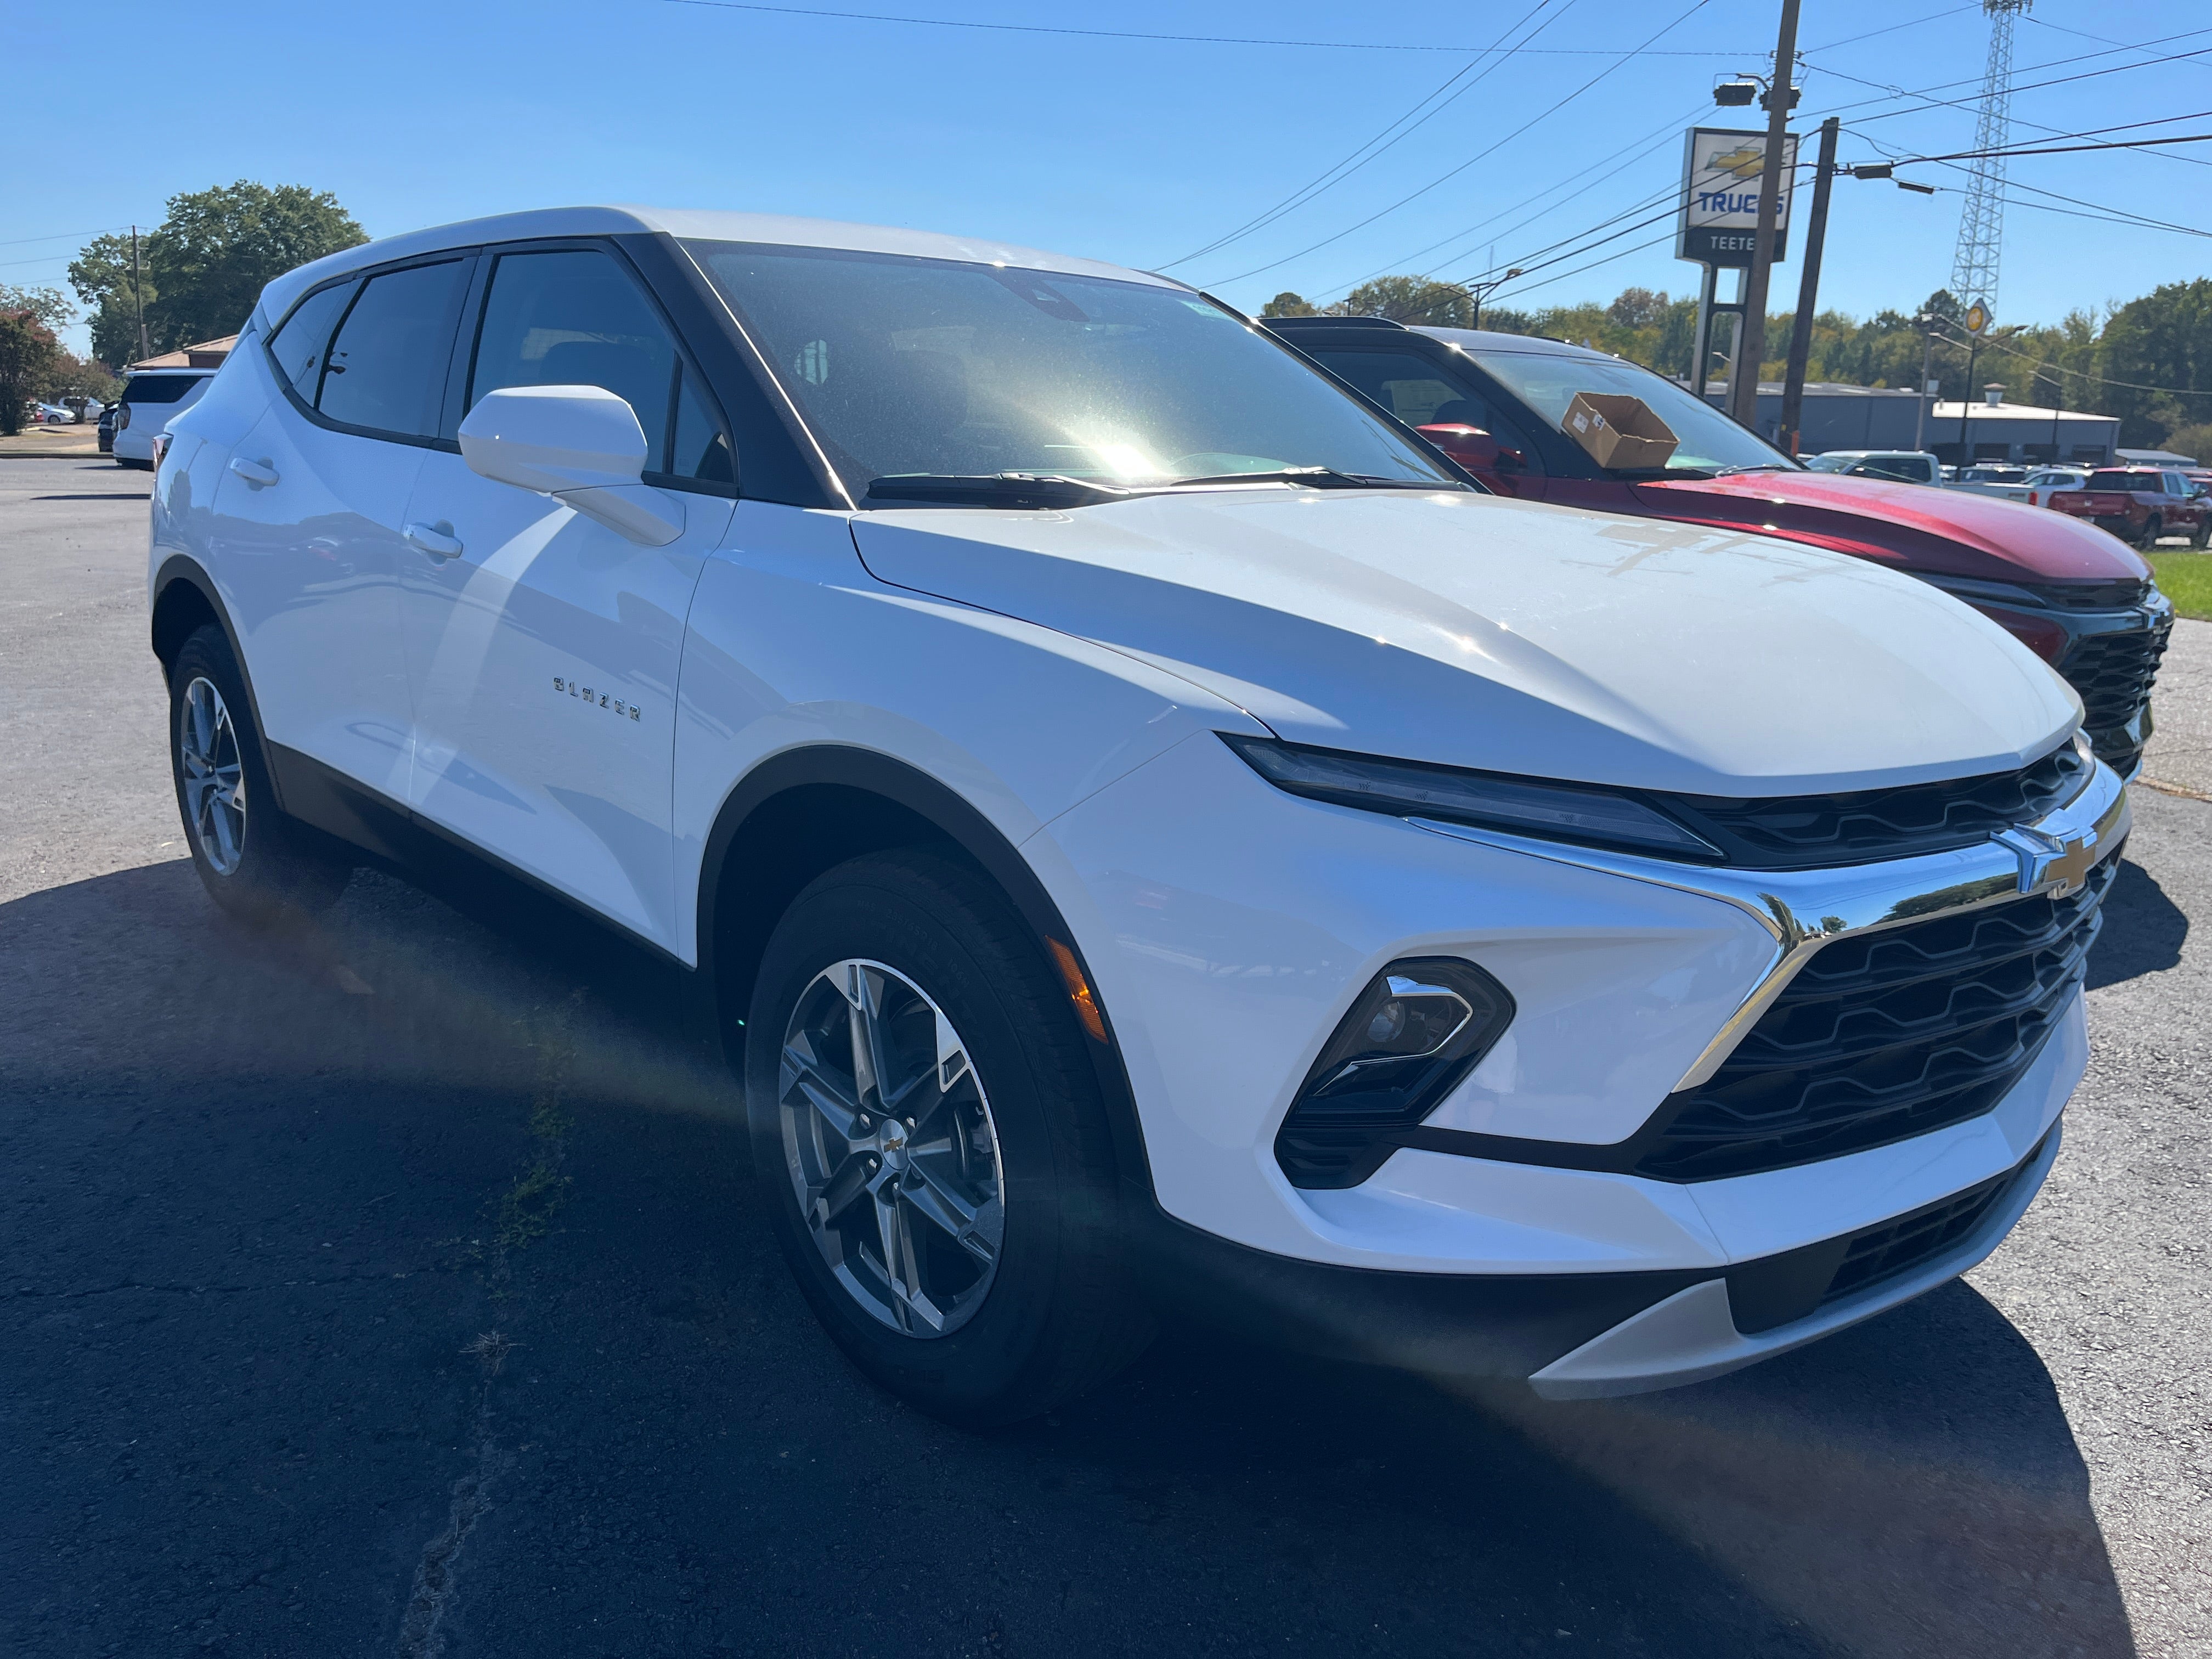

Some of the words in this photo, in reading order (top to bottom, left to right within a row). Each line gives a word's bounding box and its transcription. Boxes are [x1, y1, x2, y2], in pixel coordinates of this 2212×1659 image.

[1699, 192, 1784, 215] TRUCS
[1710, 236, 1755, 251] TEETE
[553, 676, 641, 722] BLAZER
